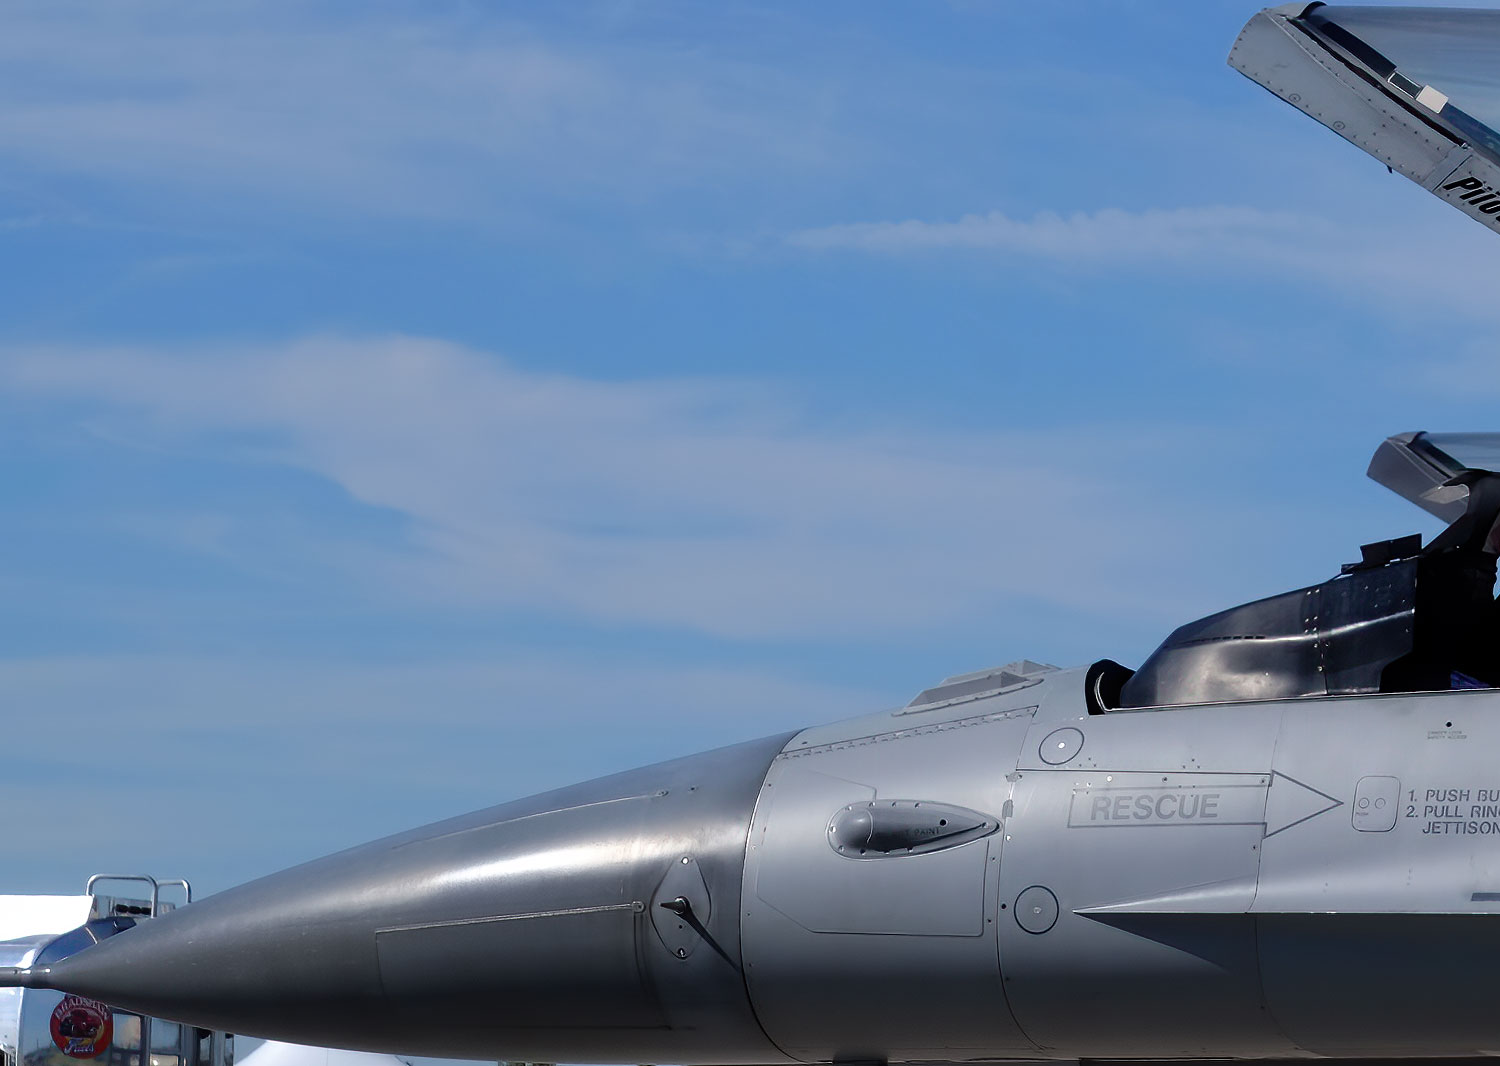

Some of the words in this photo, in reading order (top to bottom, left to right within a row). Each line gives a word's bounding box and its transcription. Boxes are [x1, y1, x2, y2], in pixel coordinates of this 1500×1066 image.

[1407, 788, 1418, 802] 1.
[1425, 788, 1470, 803] PUSH
[1090, 793, 1220, 821] RESCUE
[1405, 805, 1419, 818] 2.
[1424, 805, 1464, 818] PULL
[914, 826, 940, 837] PAINT
